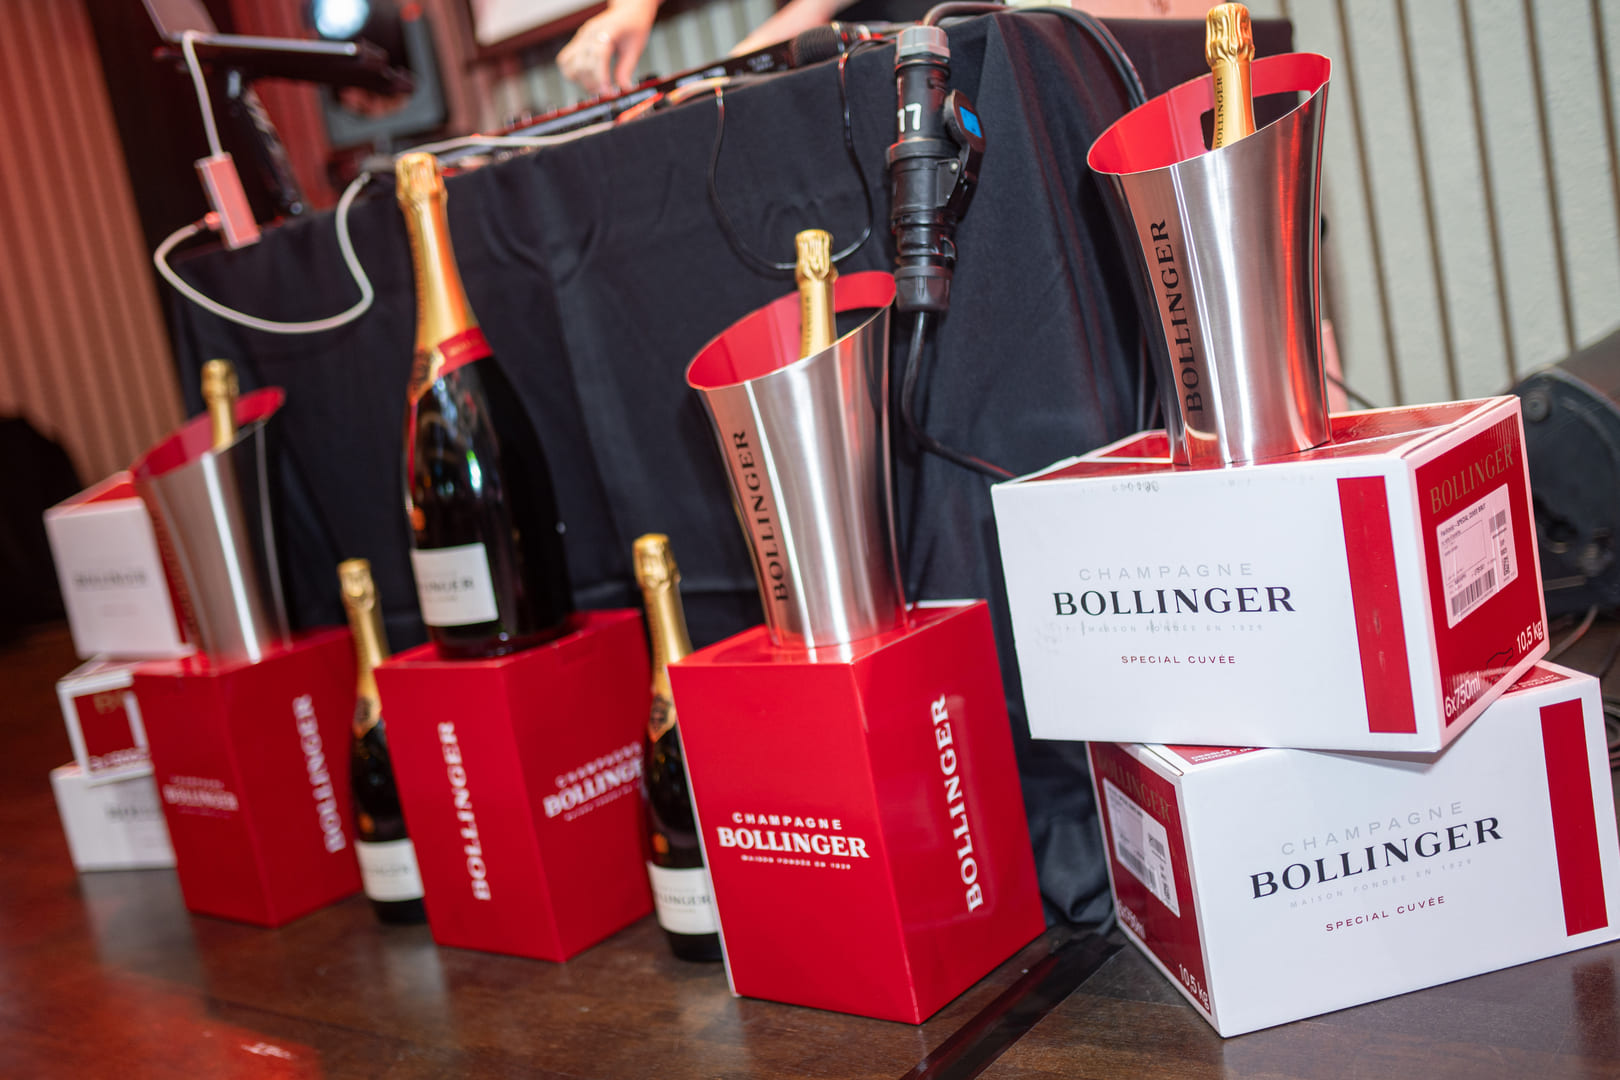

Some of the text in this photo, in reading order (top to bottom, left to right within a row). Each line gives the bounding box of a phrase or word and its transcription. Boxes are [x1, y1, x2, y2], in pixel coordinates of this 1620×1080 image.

[897, 103, 922, 132] 17
[1150, 219, 1203, 412] BOLLINGER
[1430, 443, 1514, 514] BOLLINGER
[733, 429, 788, 601] BOLLINGER
[1079, 563, 1252, 581] CHAMPAGNE
[1053, 585, 1296, 616] BOLLINGER
[1206, 624, 1222, 632] EN
[1516, 620, 1543, 654] 10,5 kg
[1121, 653, 1236, 664] SPECIAL CUVÉE
[1445, 671, 1481, 718] 6x750ml
[292, 693, 346, 853] BOLLINGER
[437, 720, 492, 901] BOLLINGER
[732, 812, 842, 831] CHAMPAGNE
[931, 693, 984, 913] BOLLINGER
[716, 826, 871, 858] BOLLINGER
[1281, 801, 1464, 856] CHAMPAGNE
[1250, 816, 1503, 899] BOLLINGER
[1289, 889, 1344, 909] MAISON
[1353, 874, 1408, 894] FONDÉE
[1415, 868, 1432, 879] EN
[1325, 895, 1446, 932] SPECIAL CUVÉE
